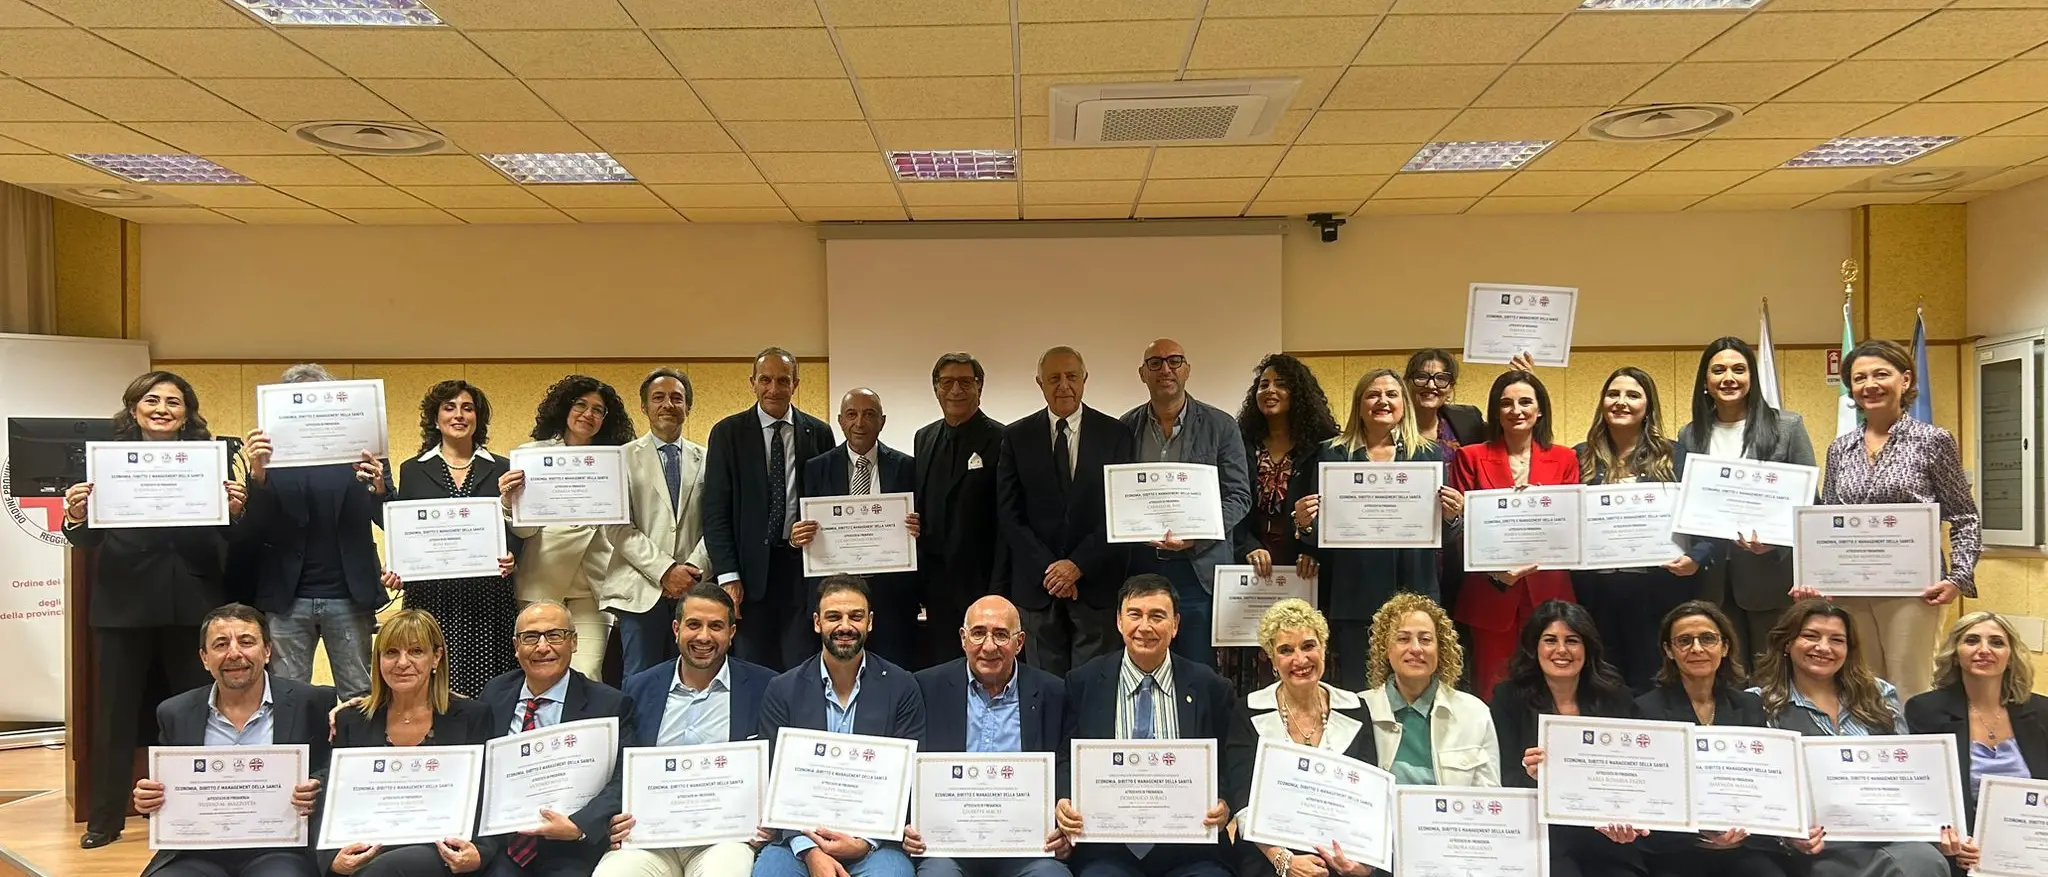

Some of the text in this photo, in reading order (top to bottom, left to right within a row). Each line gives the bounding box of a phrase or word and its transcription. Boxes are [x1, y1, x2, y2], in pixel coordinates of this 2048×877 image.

[12, 577, 60, 588] Ordine dei
[38, 598, 61, 608] degli
[0, 610, 23, 620] della
